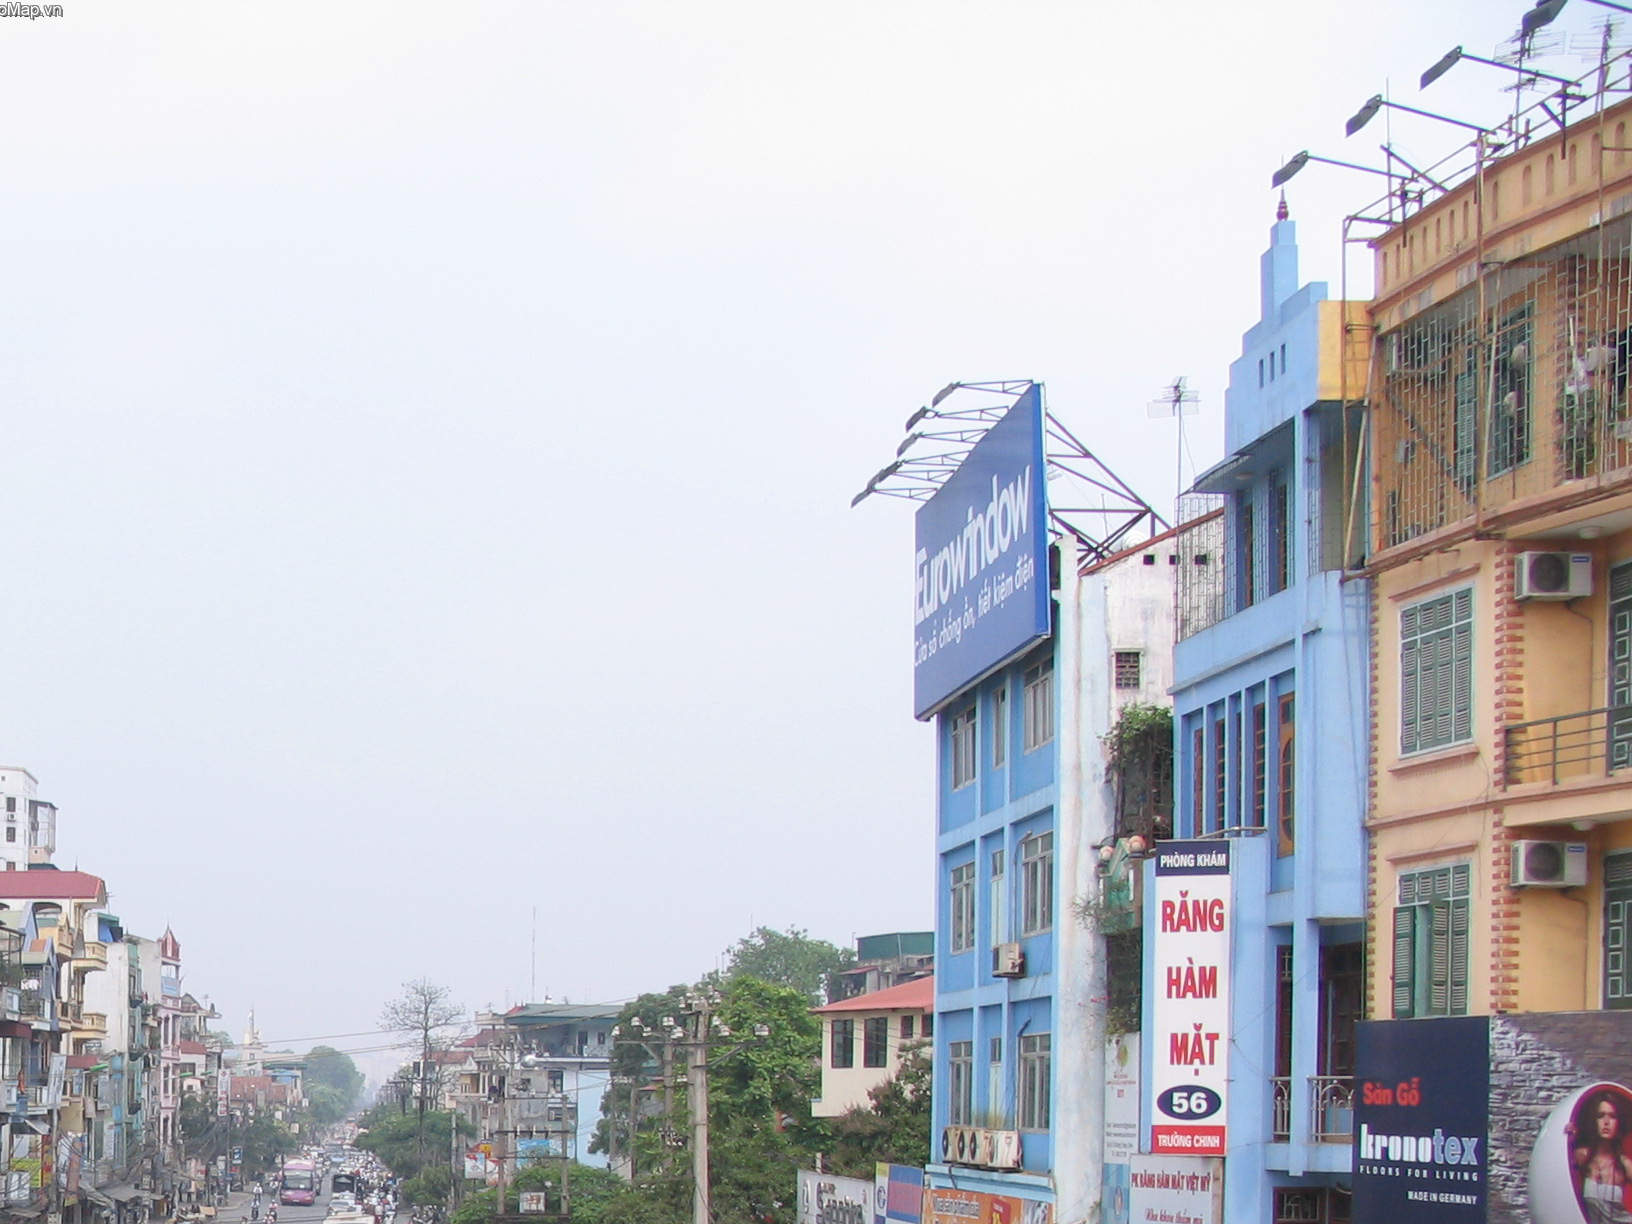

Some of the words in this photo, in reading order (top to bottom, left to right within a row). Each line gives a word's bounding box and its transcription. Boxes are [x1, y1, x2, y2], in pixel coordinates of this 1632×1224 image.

[915, 465, 1031, 626] Eurowindow
[1160, 853, 1195, 869] PHÒNG
[1197, 851, 1226, 867] KHÁM
[1161, 890, 1225, 933] RĂNG
[1166, 957, 1217, 999] HÀM
[1169, 1022, 1220, 1076] MẶT
[1171, 1092, 1208, 1114] 56
[1157, 1131, 1192, 1149] TRƯỜNG
[1193, 1133, 1220, 1148] CHINH
[1360, 1122, 1479, 1166] kronotex
[1359, 1165, 1401, 1179] FLOORS
[1407, 1168, 1429, 1179] FOR
[1435, 1170, 1479, 1182] LIVING
[1408, 1190, 1429, 1202] MADE
[1429, 1191, 1438, 1202] IN
[1439, 1192, 1477, 1205] GERMANY
